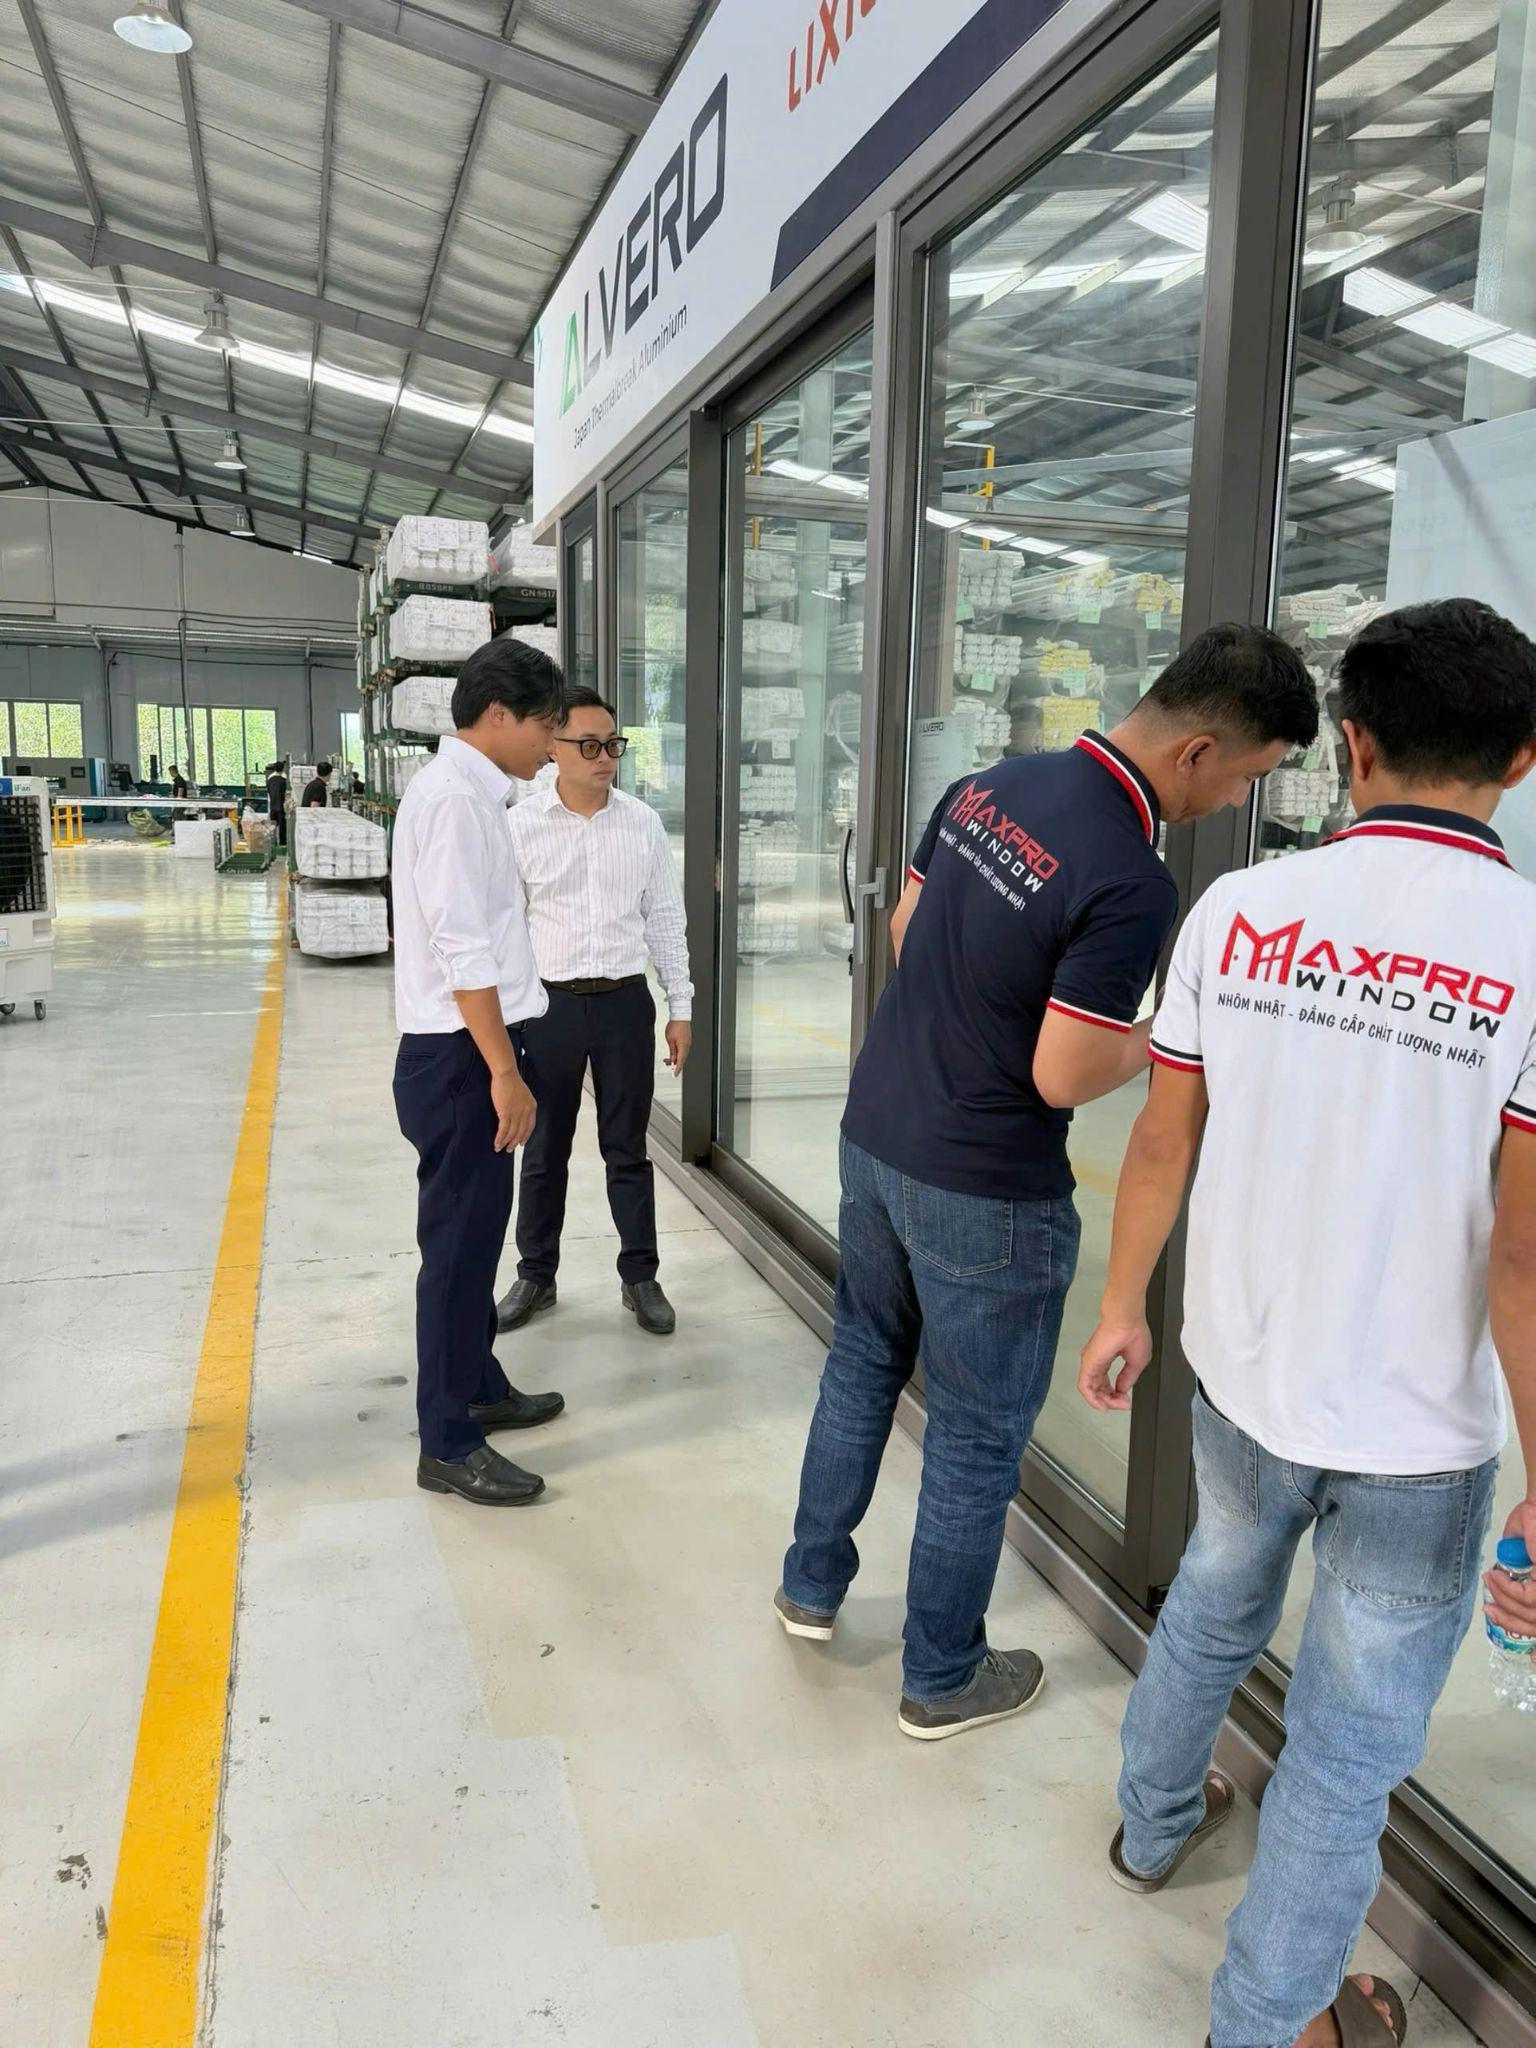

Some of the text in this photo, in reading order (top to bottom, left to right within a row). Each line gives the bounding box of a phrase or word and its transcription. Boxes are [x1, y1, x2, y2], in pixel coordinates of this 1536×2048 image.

[788, 0, 876, 112] LIXI
[560, 73, 728, 417] ALVERO
[574, 416, 591, 449] Japan
[639, 304, 687, 378] Aluminium
[947, 779, 1060, 880] MAXPRO
[966, 819, 1044, 893] WINDOW
[1220, 911, 1515, 1015] MAXPRO
[1296, 970, 1501, 1038] WINDOW
[1217, 993, 1250, 1011] NHÔM
[1253, 999, 1286, 1019] NHẬT
[1339, 1013, 1366, 1034] CẤP
[1396, 1030, 1442, 1056] LƯỢNG
[1446, 1047, 1486, 1069] NHẬT
